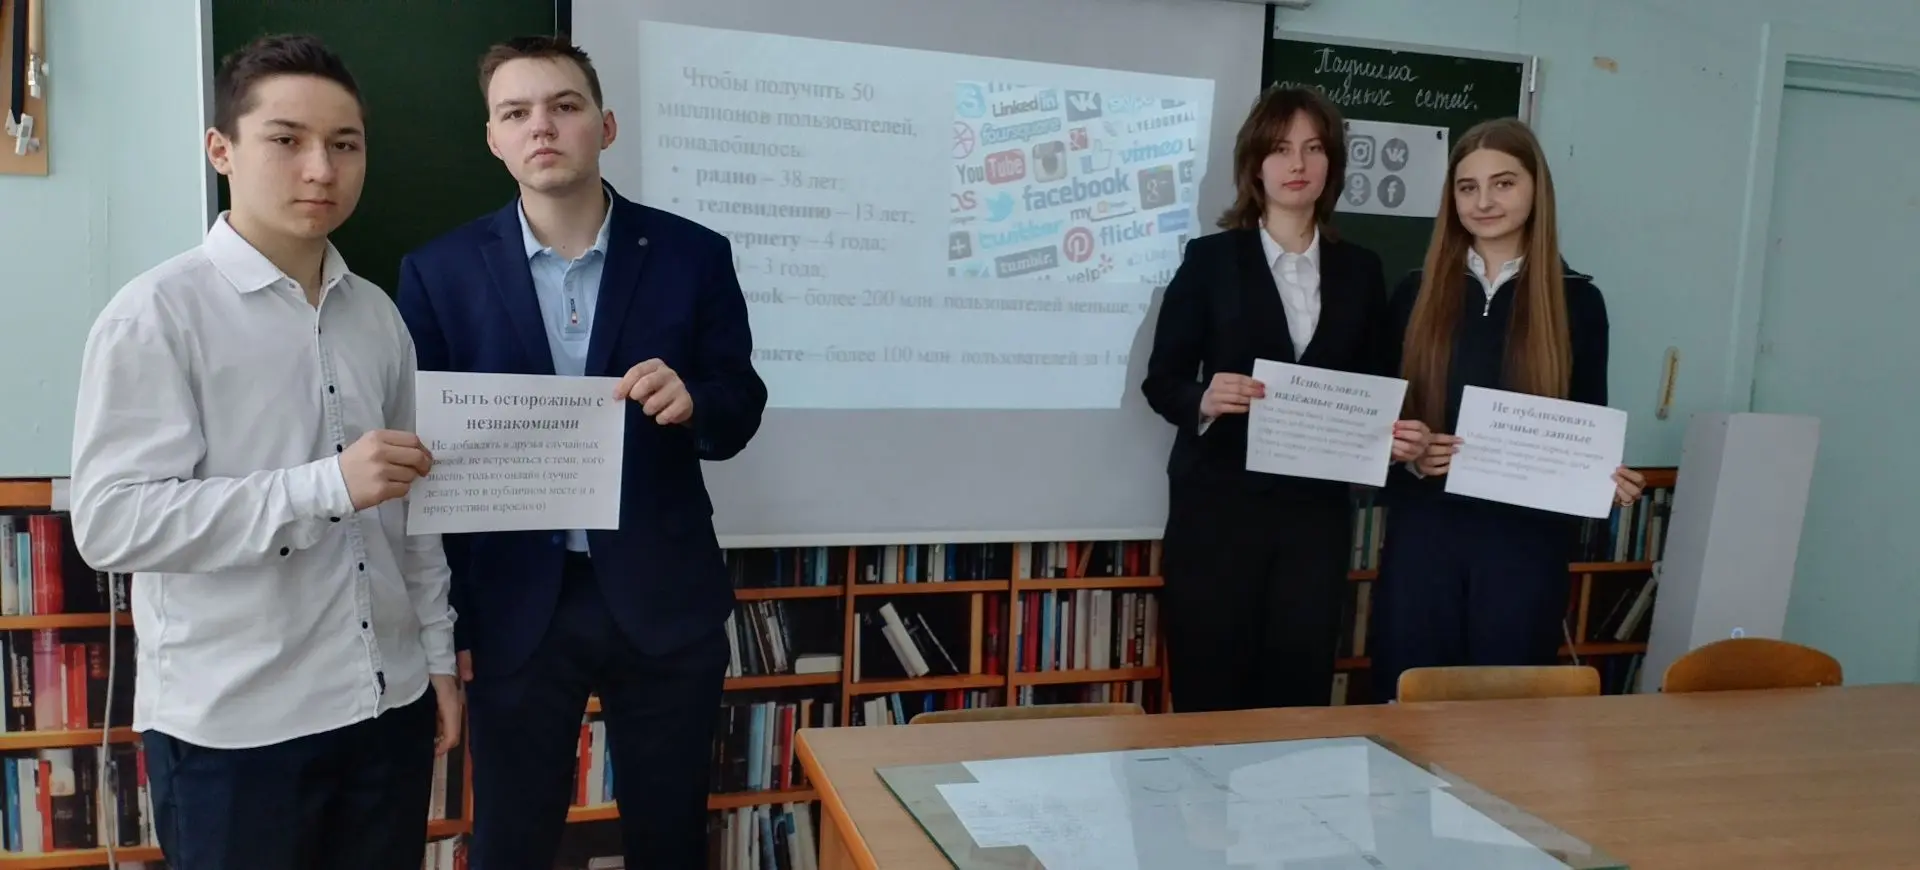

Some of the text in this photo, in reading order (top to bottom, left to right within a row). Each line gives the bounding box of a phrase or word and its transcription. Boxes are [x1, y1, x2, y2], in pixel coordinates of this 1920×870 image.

[682, 66, 874, 102] Чтобы получить 50
[657, 102, 917, 138] миллионов пользователей,
[696, 167, 757, 187] радио
[780, 169, 802, 188] 38
[1022, 168, 1131, 211] facebook
[697, 197, 831, 220] телевидению
[855, 203, 873, 221] 13
[823, 230, 835, 249] 4
[1100, 220, 1155, 246] flickr
[763, 257, 772, 275] 3
[804, 287, 856, 306] более
[943, 296, 1063, 313] пользователей
[825, 345, 876, 363] более
[961, 349, 1078, 366] пользователей
[1290, 375, 1371, 398] Использовать
[441, 389, 604, 410] Быть осторожным с
[1335, 402, 1379, 416] пароли
[466, 418, 579, 431] незнакомцами
[1492, 401, 1596, 428] Не публиковать
[1489, 420, 1592, 444] личные данные
[432, 440, 447, 450] Не
